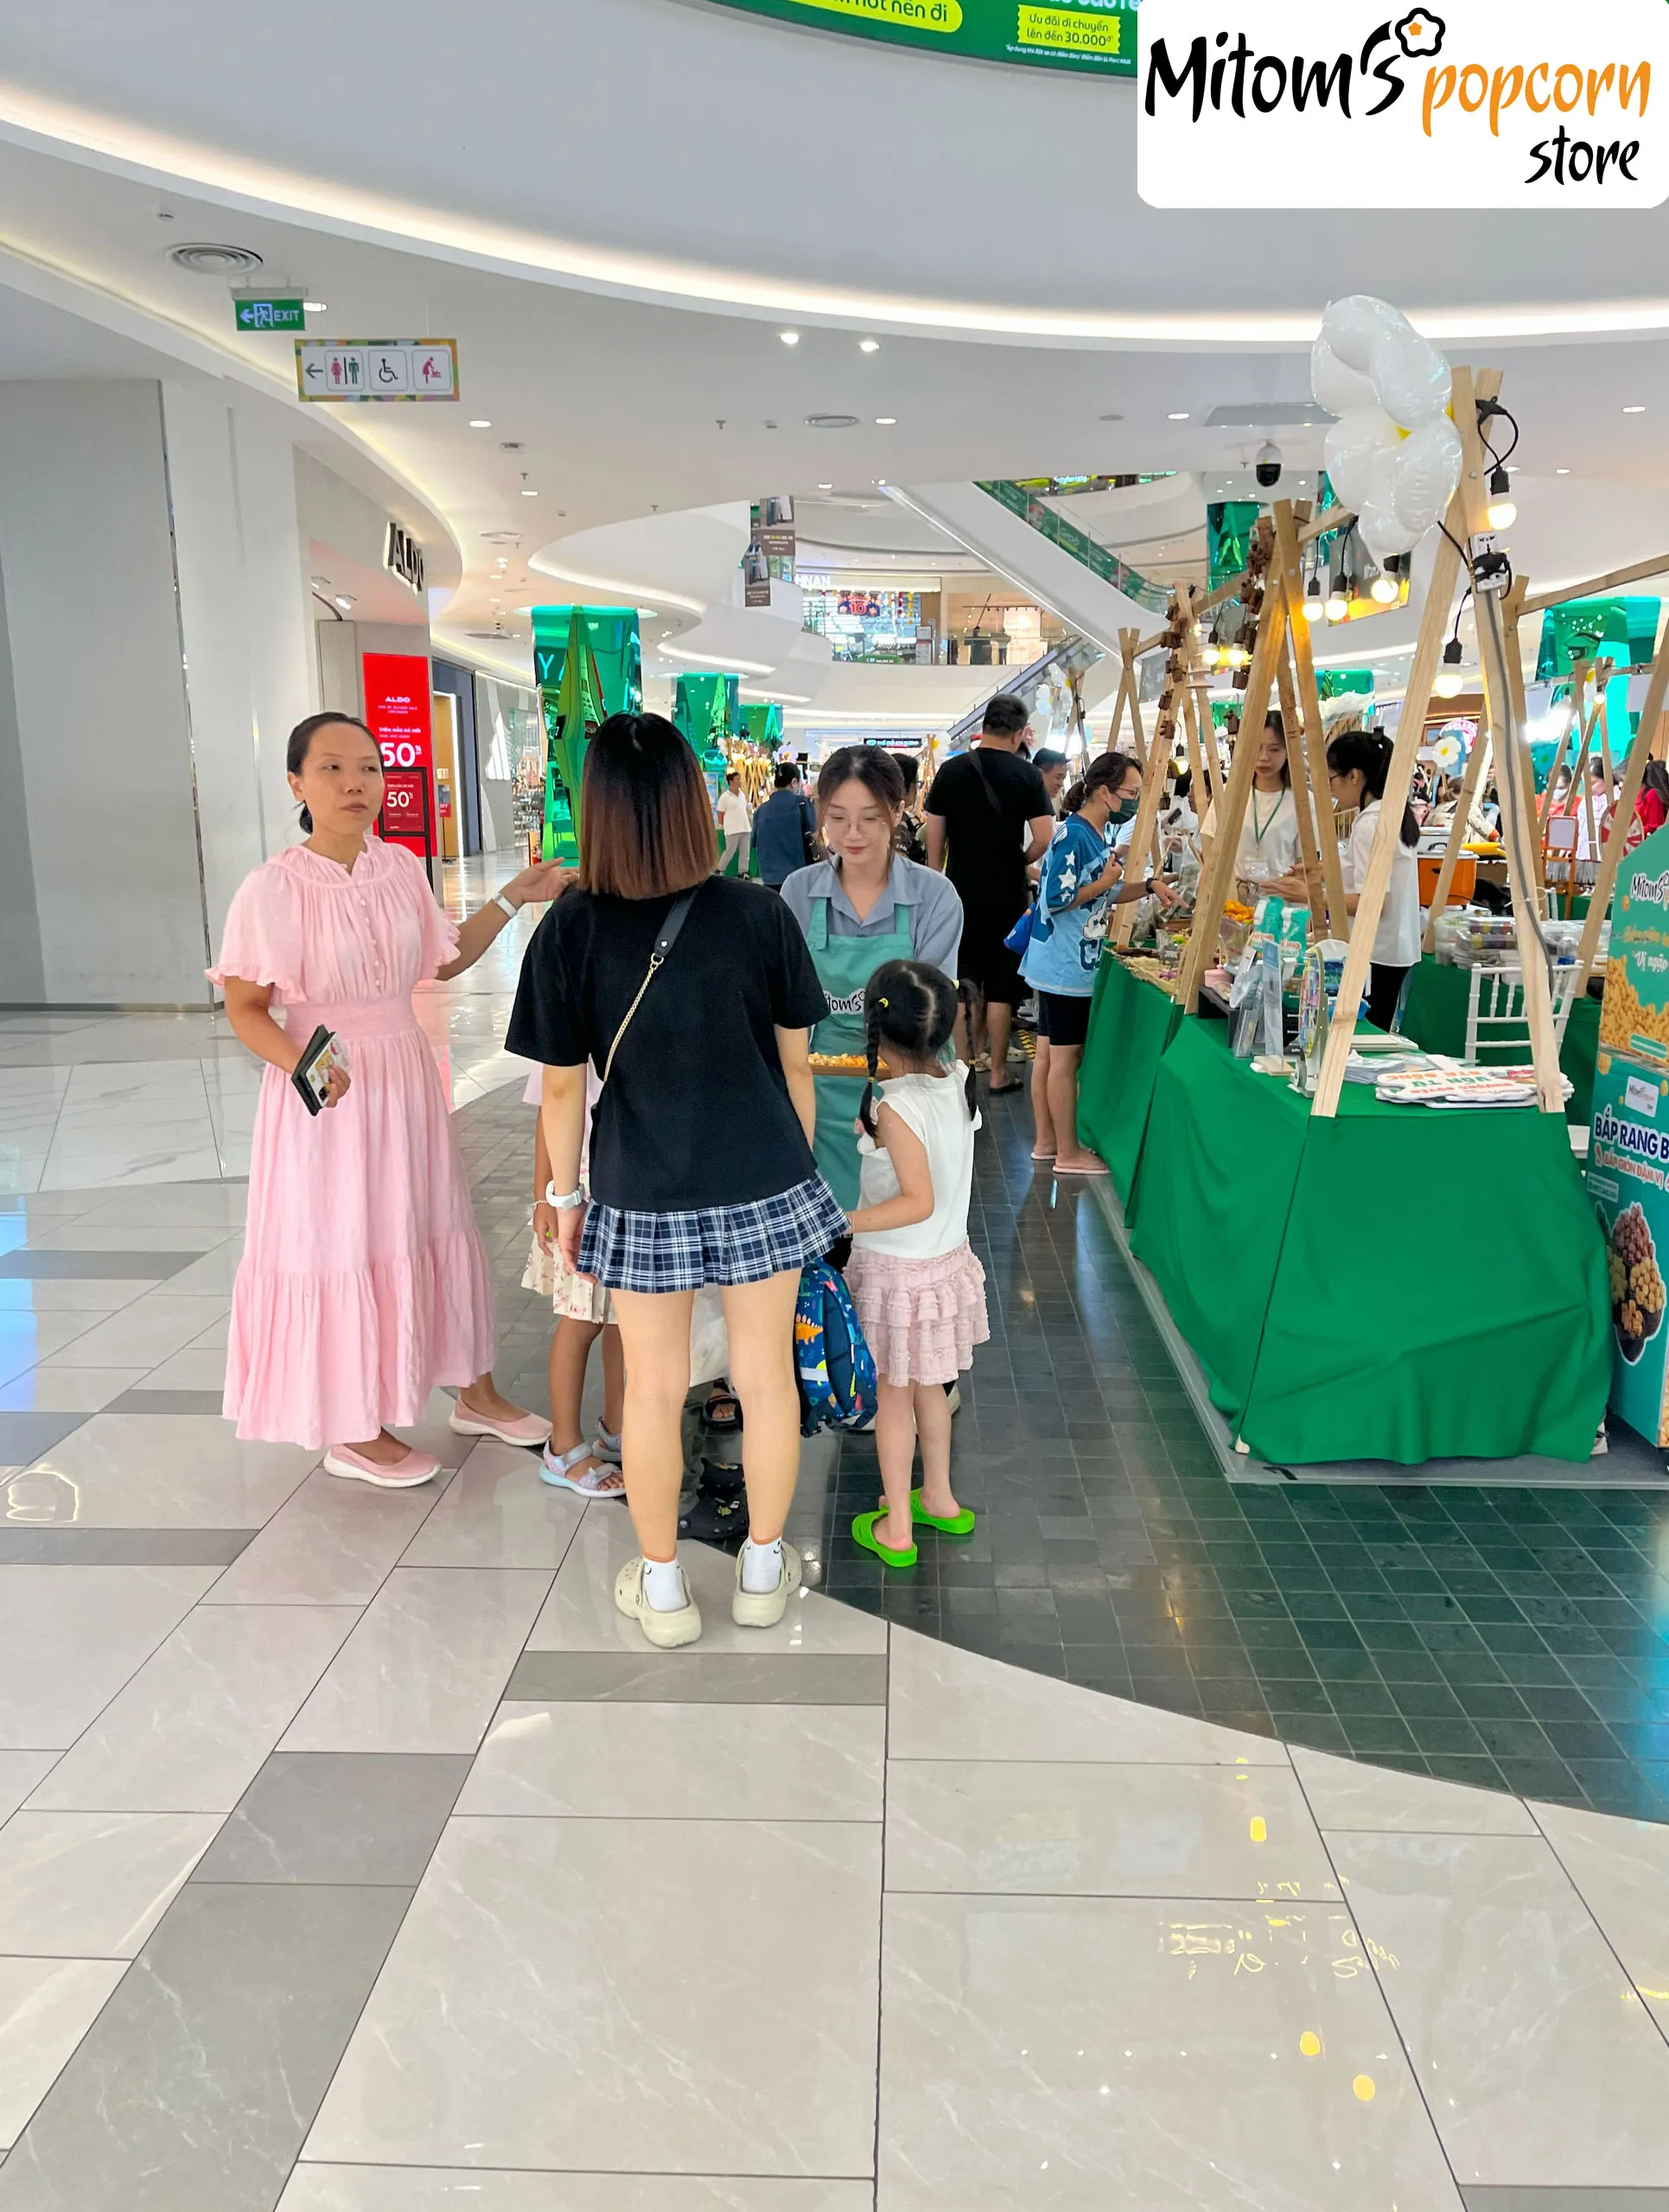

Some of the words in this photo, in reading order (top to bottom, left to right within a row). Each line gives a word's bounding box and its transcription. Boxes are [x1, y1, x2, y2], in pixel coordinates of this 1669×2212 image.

[931, 3, 947, 22] đi
[274, 309, 299, 322] EXIT
[825, 992, 862, 1012] tom's
[1596, 1106, 1618, 1141] BẮP
[1620, 1124, 1658, 1155] RANG
